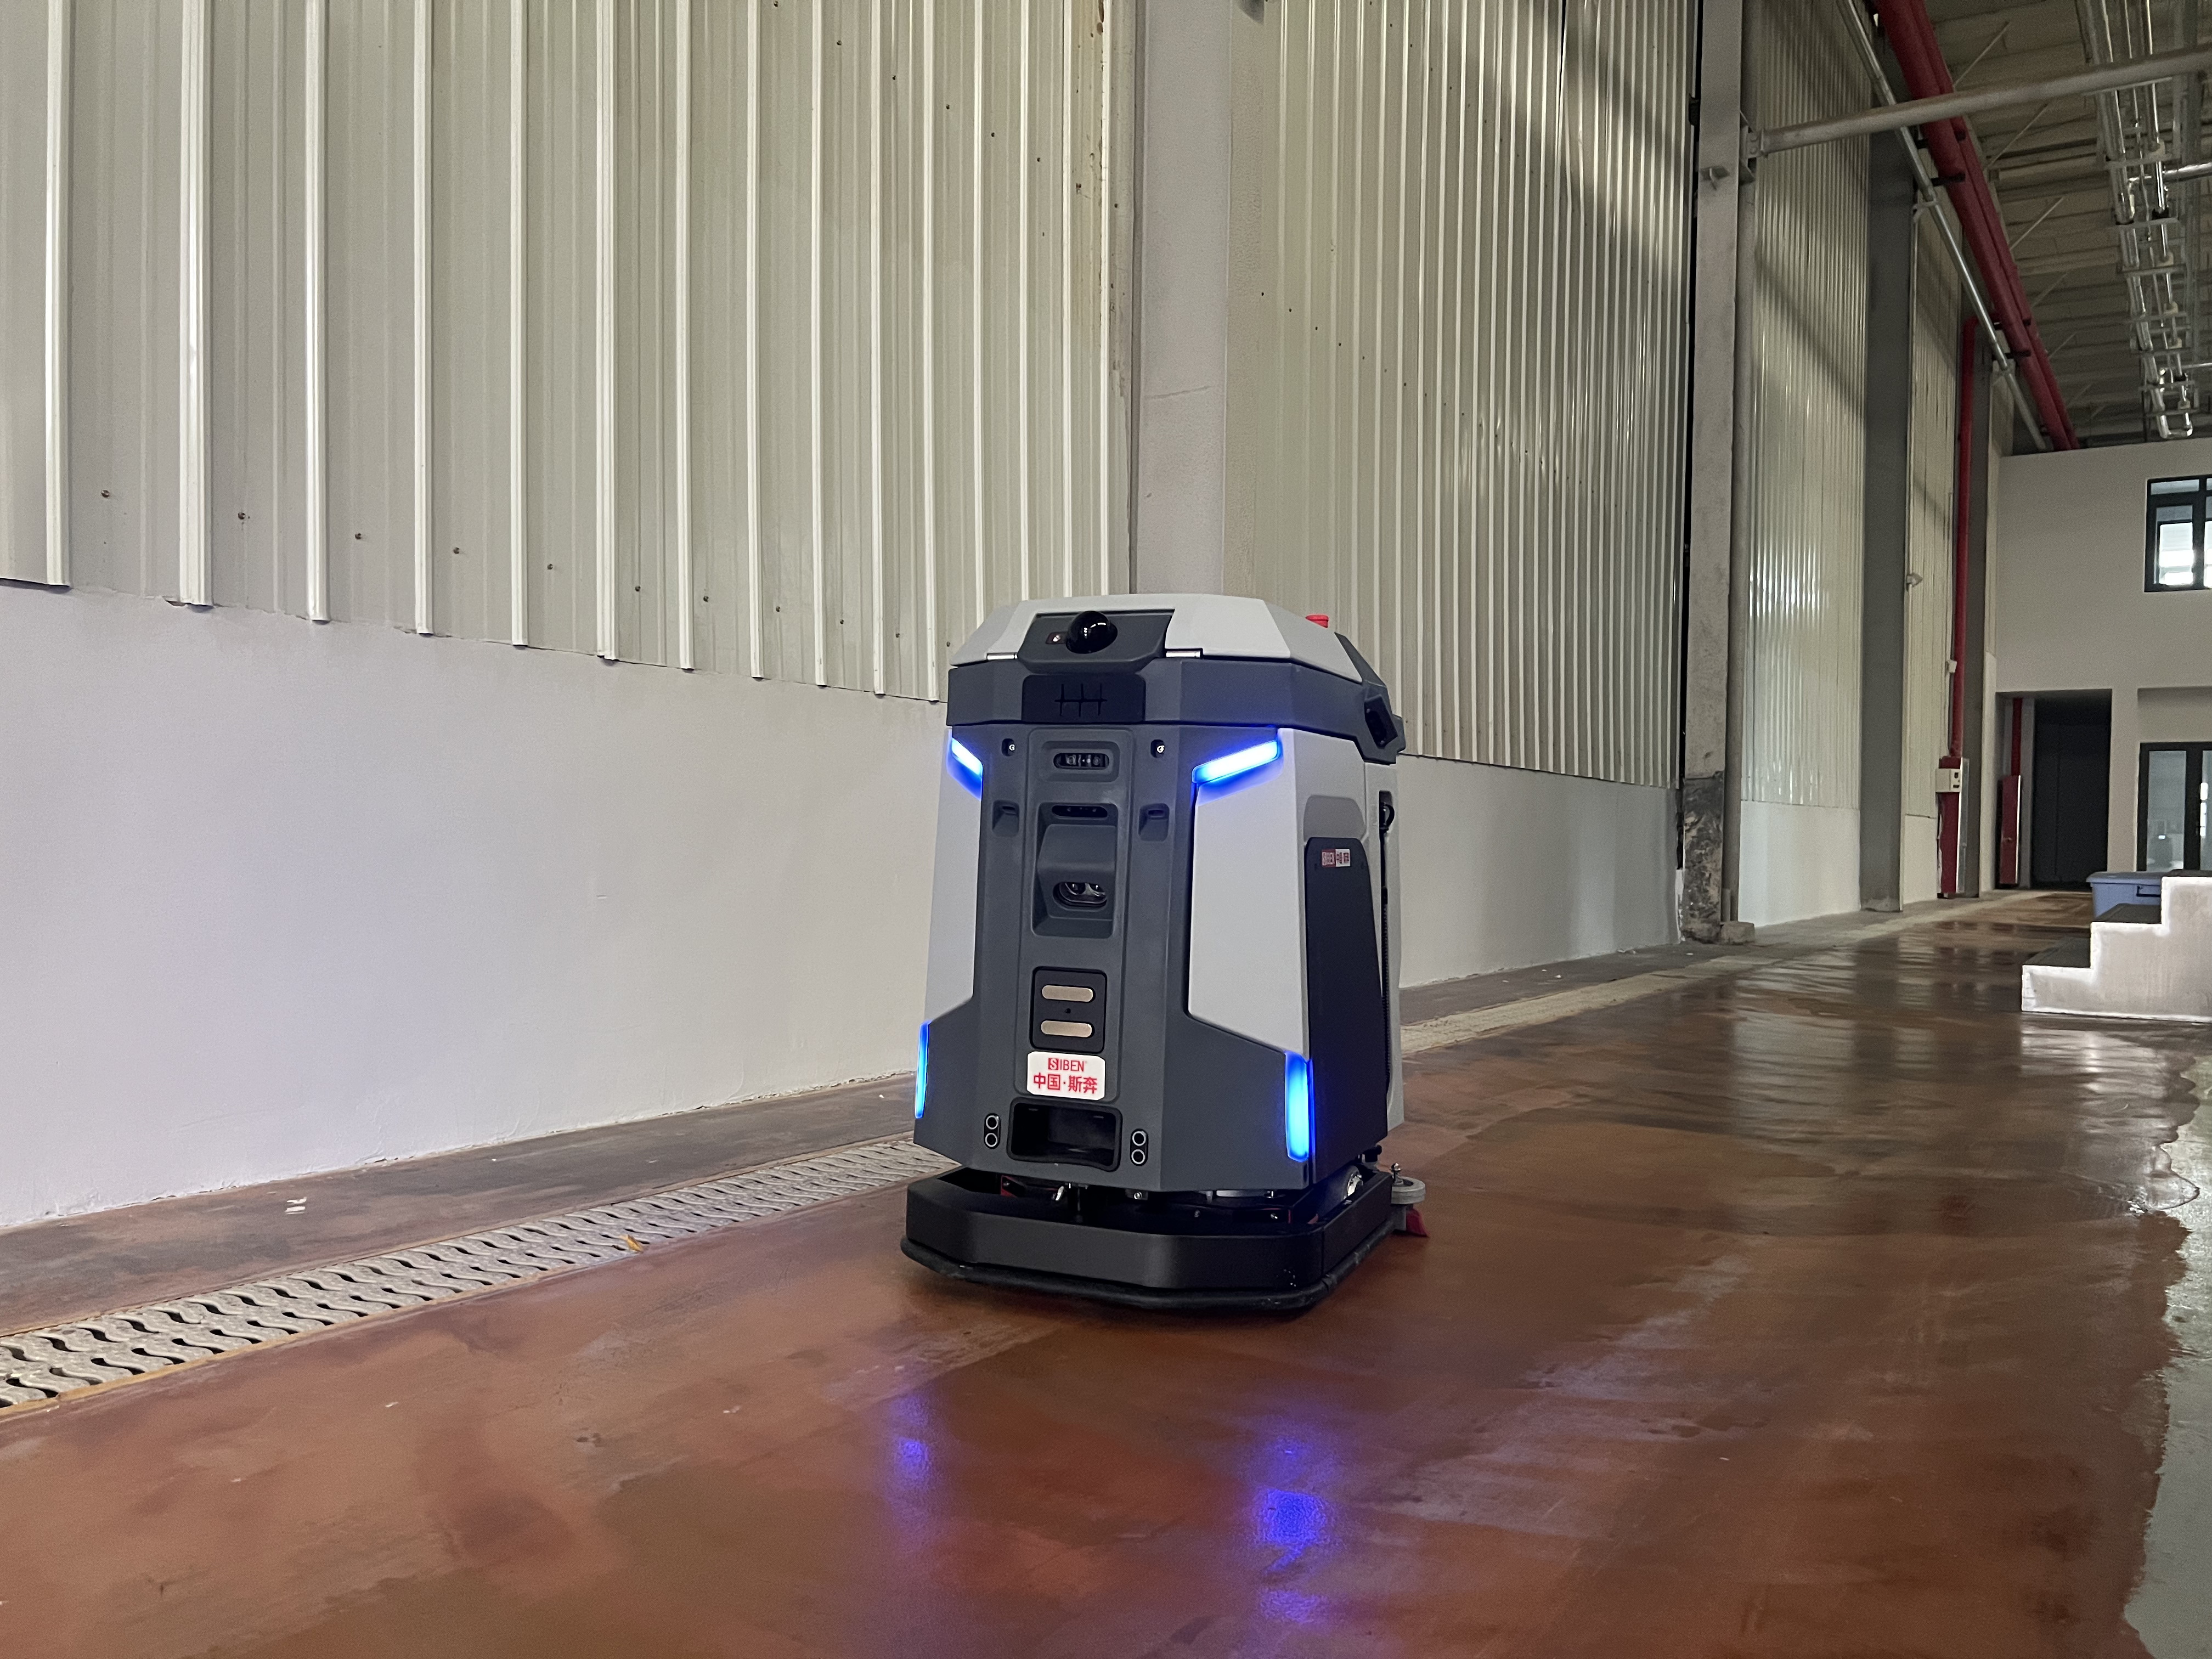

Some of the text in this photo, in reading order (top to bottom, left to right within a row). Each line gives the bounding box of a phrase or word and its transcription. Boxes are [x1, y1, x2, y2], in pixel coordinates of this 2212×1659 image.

[1048, 1058, 1084, 1072] SIBEN
[1033, 1072, 1098, 1094] 中国·斯奔
